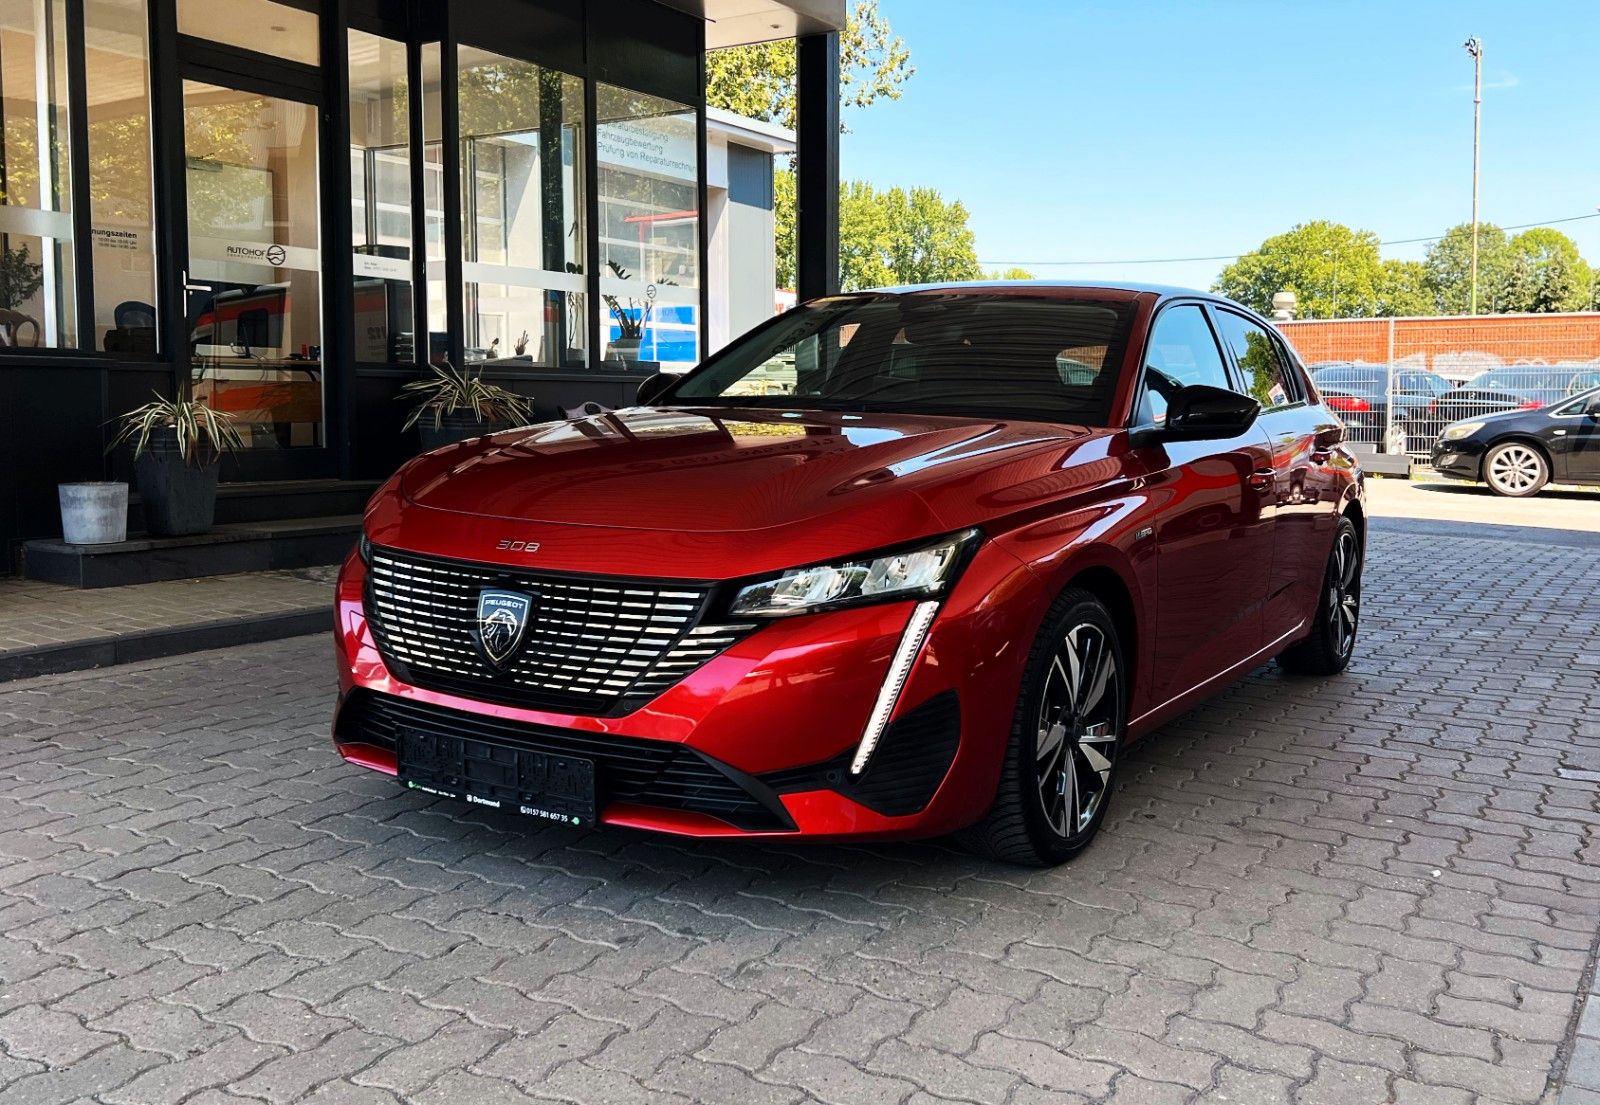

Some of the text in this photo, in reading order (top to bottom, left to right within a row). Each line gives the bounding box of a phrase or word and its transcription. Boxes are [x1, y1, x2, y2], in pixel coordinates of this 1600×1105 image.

[598, 128, 663, 154] Fahrzeugbewertung
[627, 151, 639, 159] von
[227, 246, 265, 256] AUTOHOF
[496, 540, 540, 553] 308
[485, 599, 523, 609] PEUGEOT
[473, 795, 500, 808] Dortmund
[526, 808, 540, 816] 0157
